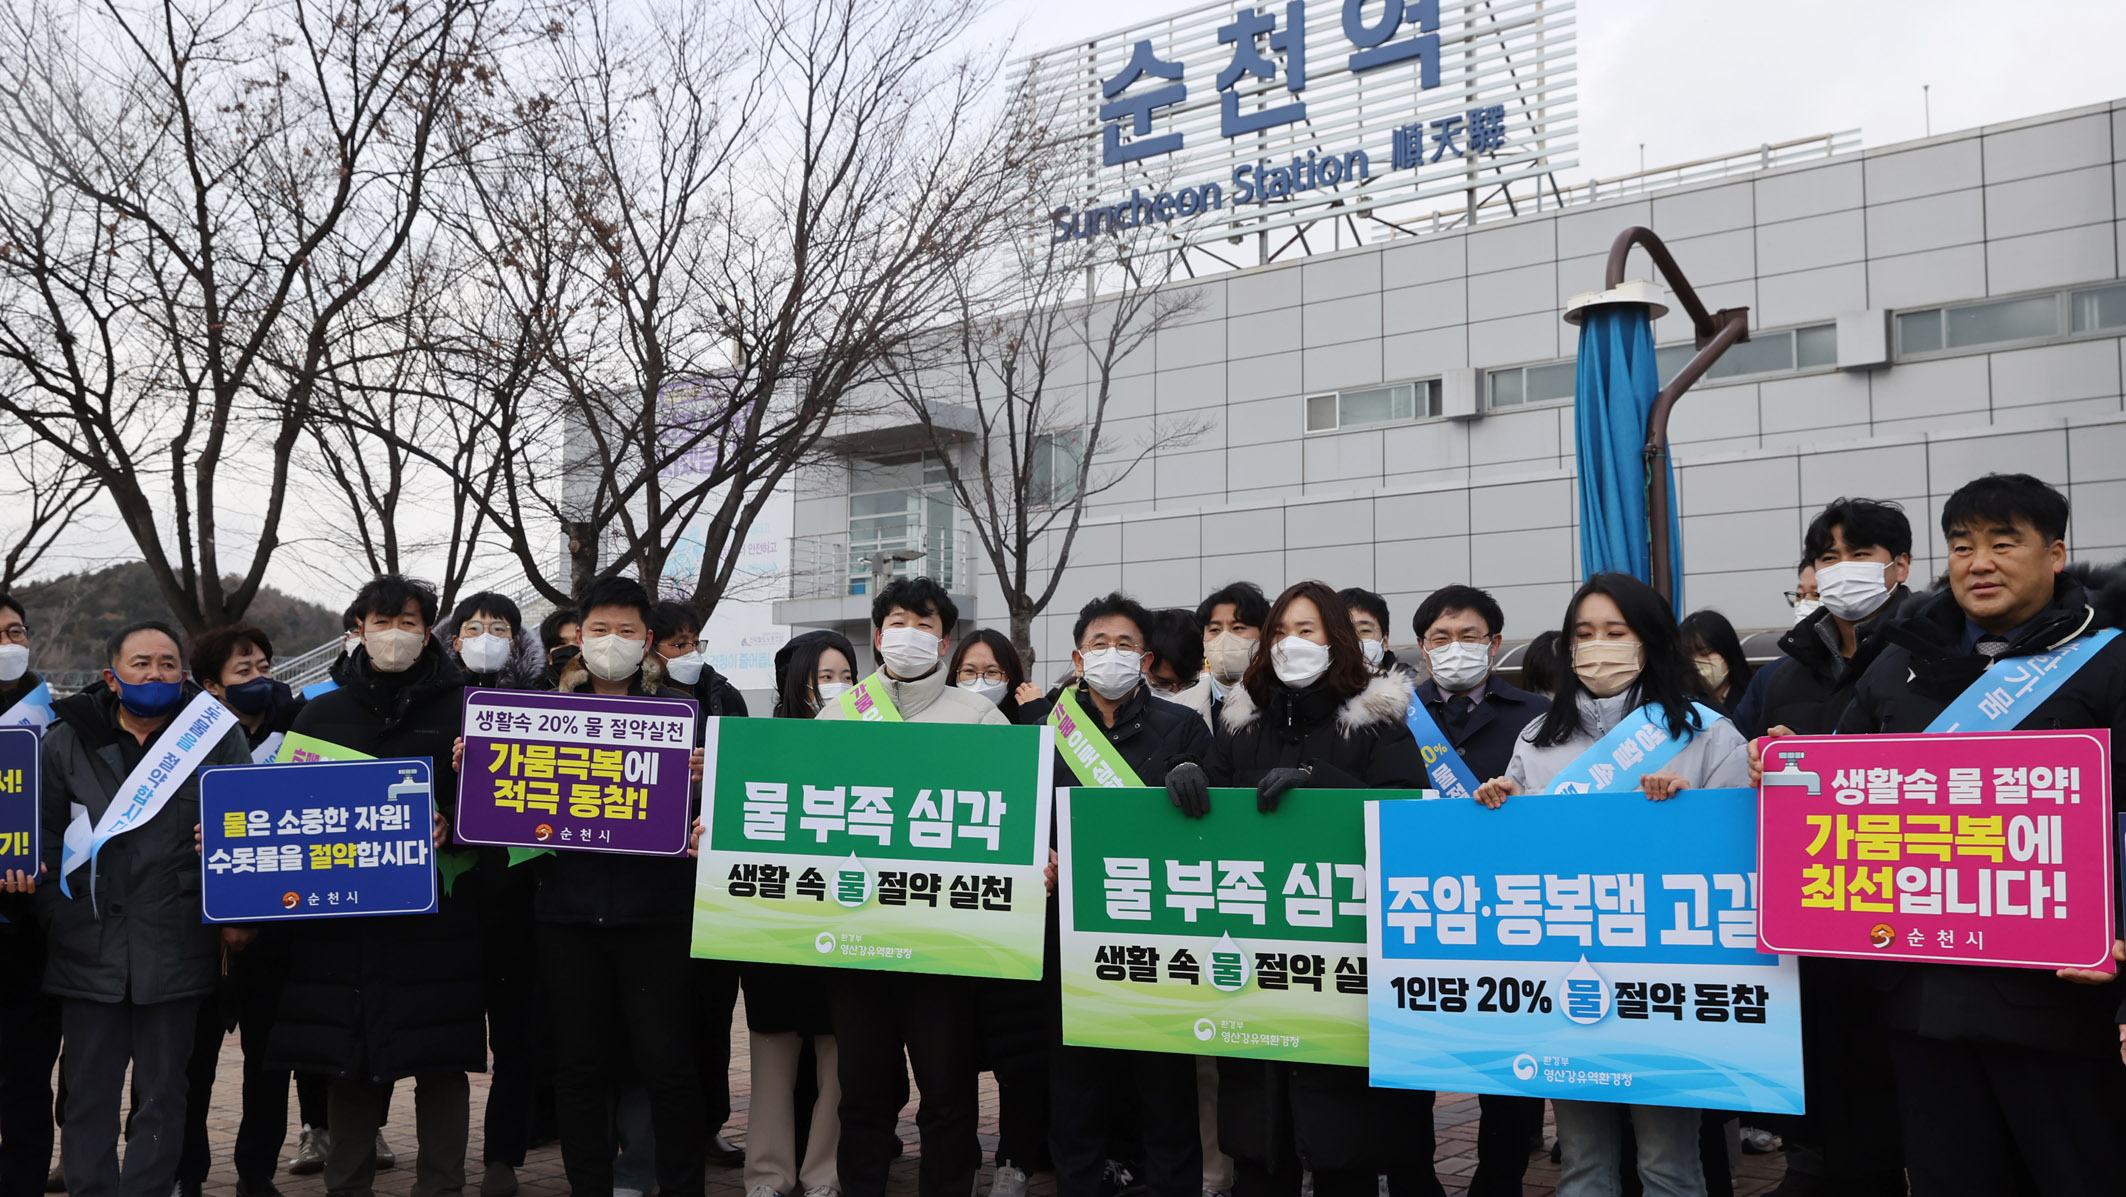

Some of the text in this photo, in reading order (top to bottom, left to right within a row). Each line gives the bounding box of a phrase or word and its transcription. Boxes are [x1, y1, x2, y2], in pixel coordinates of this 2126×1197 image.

[1099, 0, 1440, 167] 순천역
[1391, 103, 1506, 171] 順天驛
[1052, 147, 1369, 244] Suncheon Station
[475, 709, 685, 743] 생활속 20% 물 절약실천
[108, 700, 226, 832] 수돗물을 절약합시다
[488, 743, 660, 785] 가뭄극복에
[1419, 742, 1448, 770] 0%
[1587, 721, 1668, 791] 생활 속
[493, 778, 649, 820] 적극 동참!
[1831, 766, 2081, 805] 생활속 물 절약!
[223, 804, 411, 838] 물은 소중한 자원!
[743, 780, 1007, 851] 물 부족 심각
[1805, 813, 2063, 865] 가뭄극복에
[207, 840, 429, 874] 수돗물을 절약합시다
[727, 862, 1014, 912] 생활 속 물 절약 실천
[1103, 856, 1152, 922] 물
[1165, 858, 1267, 926] 부족
[1800, 863, 2068, 920] 최선입니다!
[1094, 944, 1160, 984] 생활
[1168, 948, 1200, 986] 속
[1211, 951, 1243, 989] 물
[1254, 952, 1326, 993] 절약
[1390, 976, 1769, 1025] 1인당 20% 물 절약 동참
[1543, 1067, 1633, 1088] 영산강유역환경청
